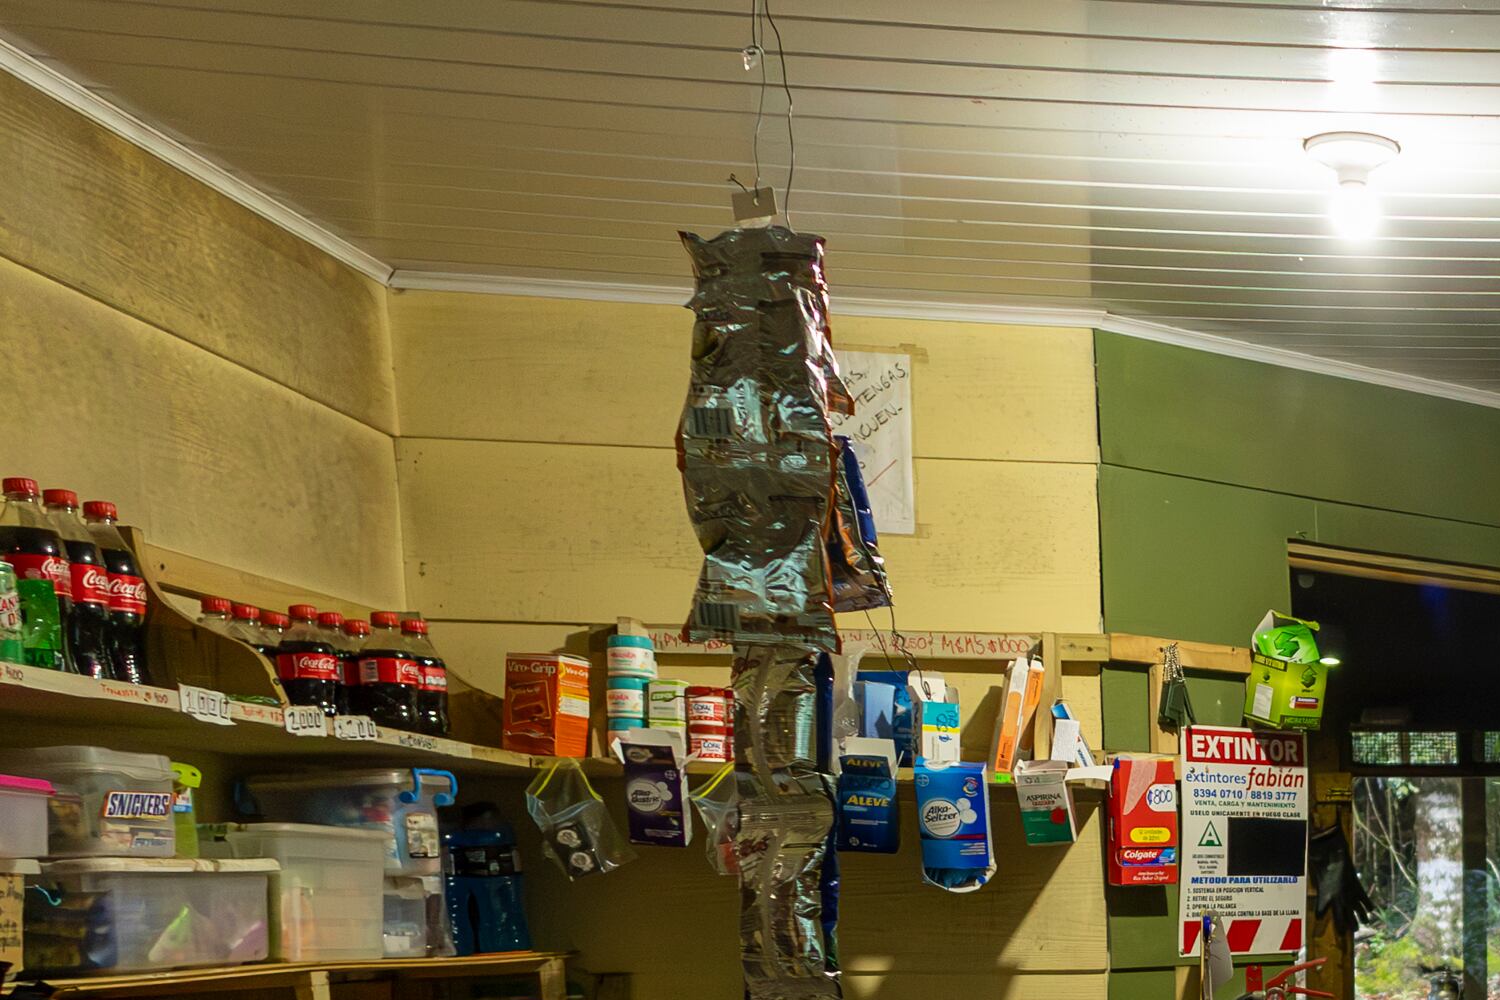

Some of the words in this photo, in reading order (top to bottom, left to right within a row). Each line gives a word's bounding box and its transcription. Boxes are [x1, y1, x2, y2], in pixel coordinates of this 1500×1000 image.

[288, 711, 322, 731] 2000
[1191, 734, 1299, 763] EXTINTOR
[1186, 771, 1247, 785] extintores
[1246, 766, 1304, 791] fabián
[846, 794, 891, 807] ALEVE
[1025, 791, 1063, 802] ASPIRINA
[1193, 788, 1217, 798] 8394
[1219, 788, 1243, 799] 0710
[1250, 790, 1273, 800] 8819
[1275, 791, 1298, 801] 3777
[107, 793, 170, 817] SNICKERS
[928, 805, 952, 814] Alka-
[1246, 801, 1296, 809] MANTENIMIENTO
[924, 811, 958, 823] Seltzer
[1123, 850, 1158, 861] Colgate
[1190, 876, 1228, 884] METODO
[1228, 876, 1251, 884] PARA
[1252, 875, 1299, 884] UTILIZARLO
